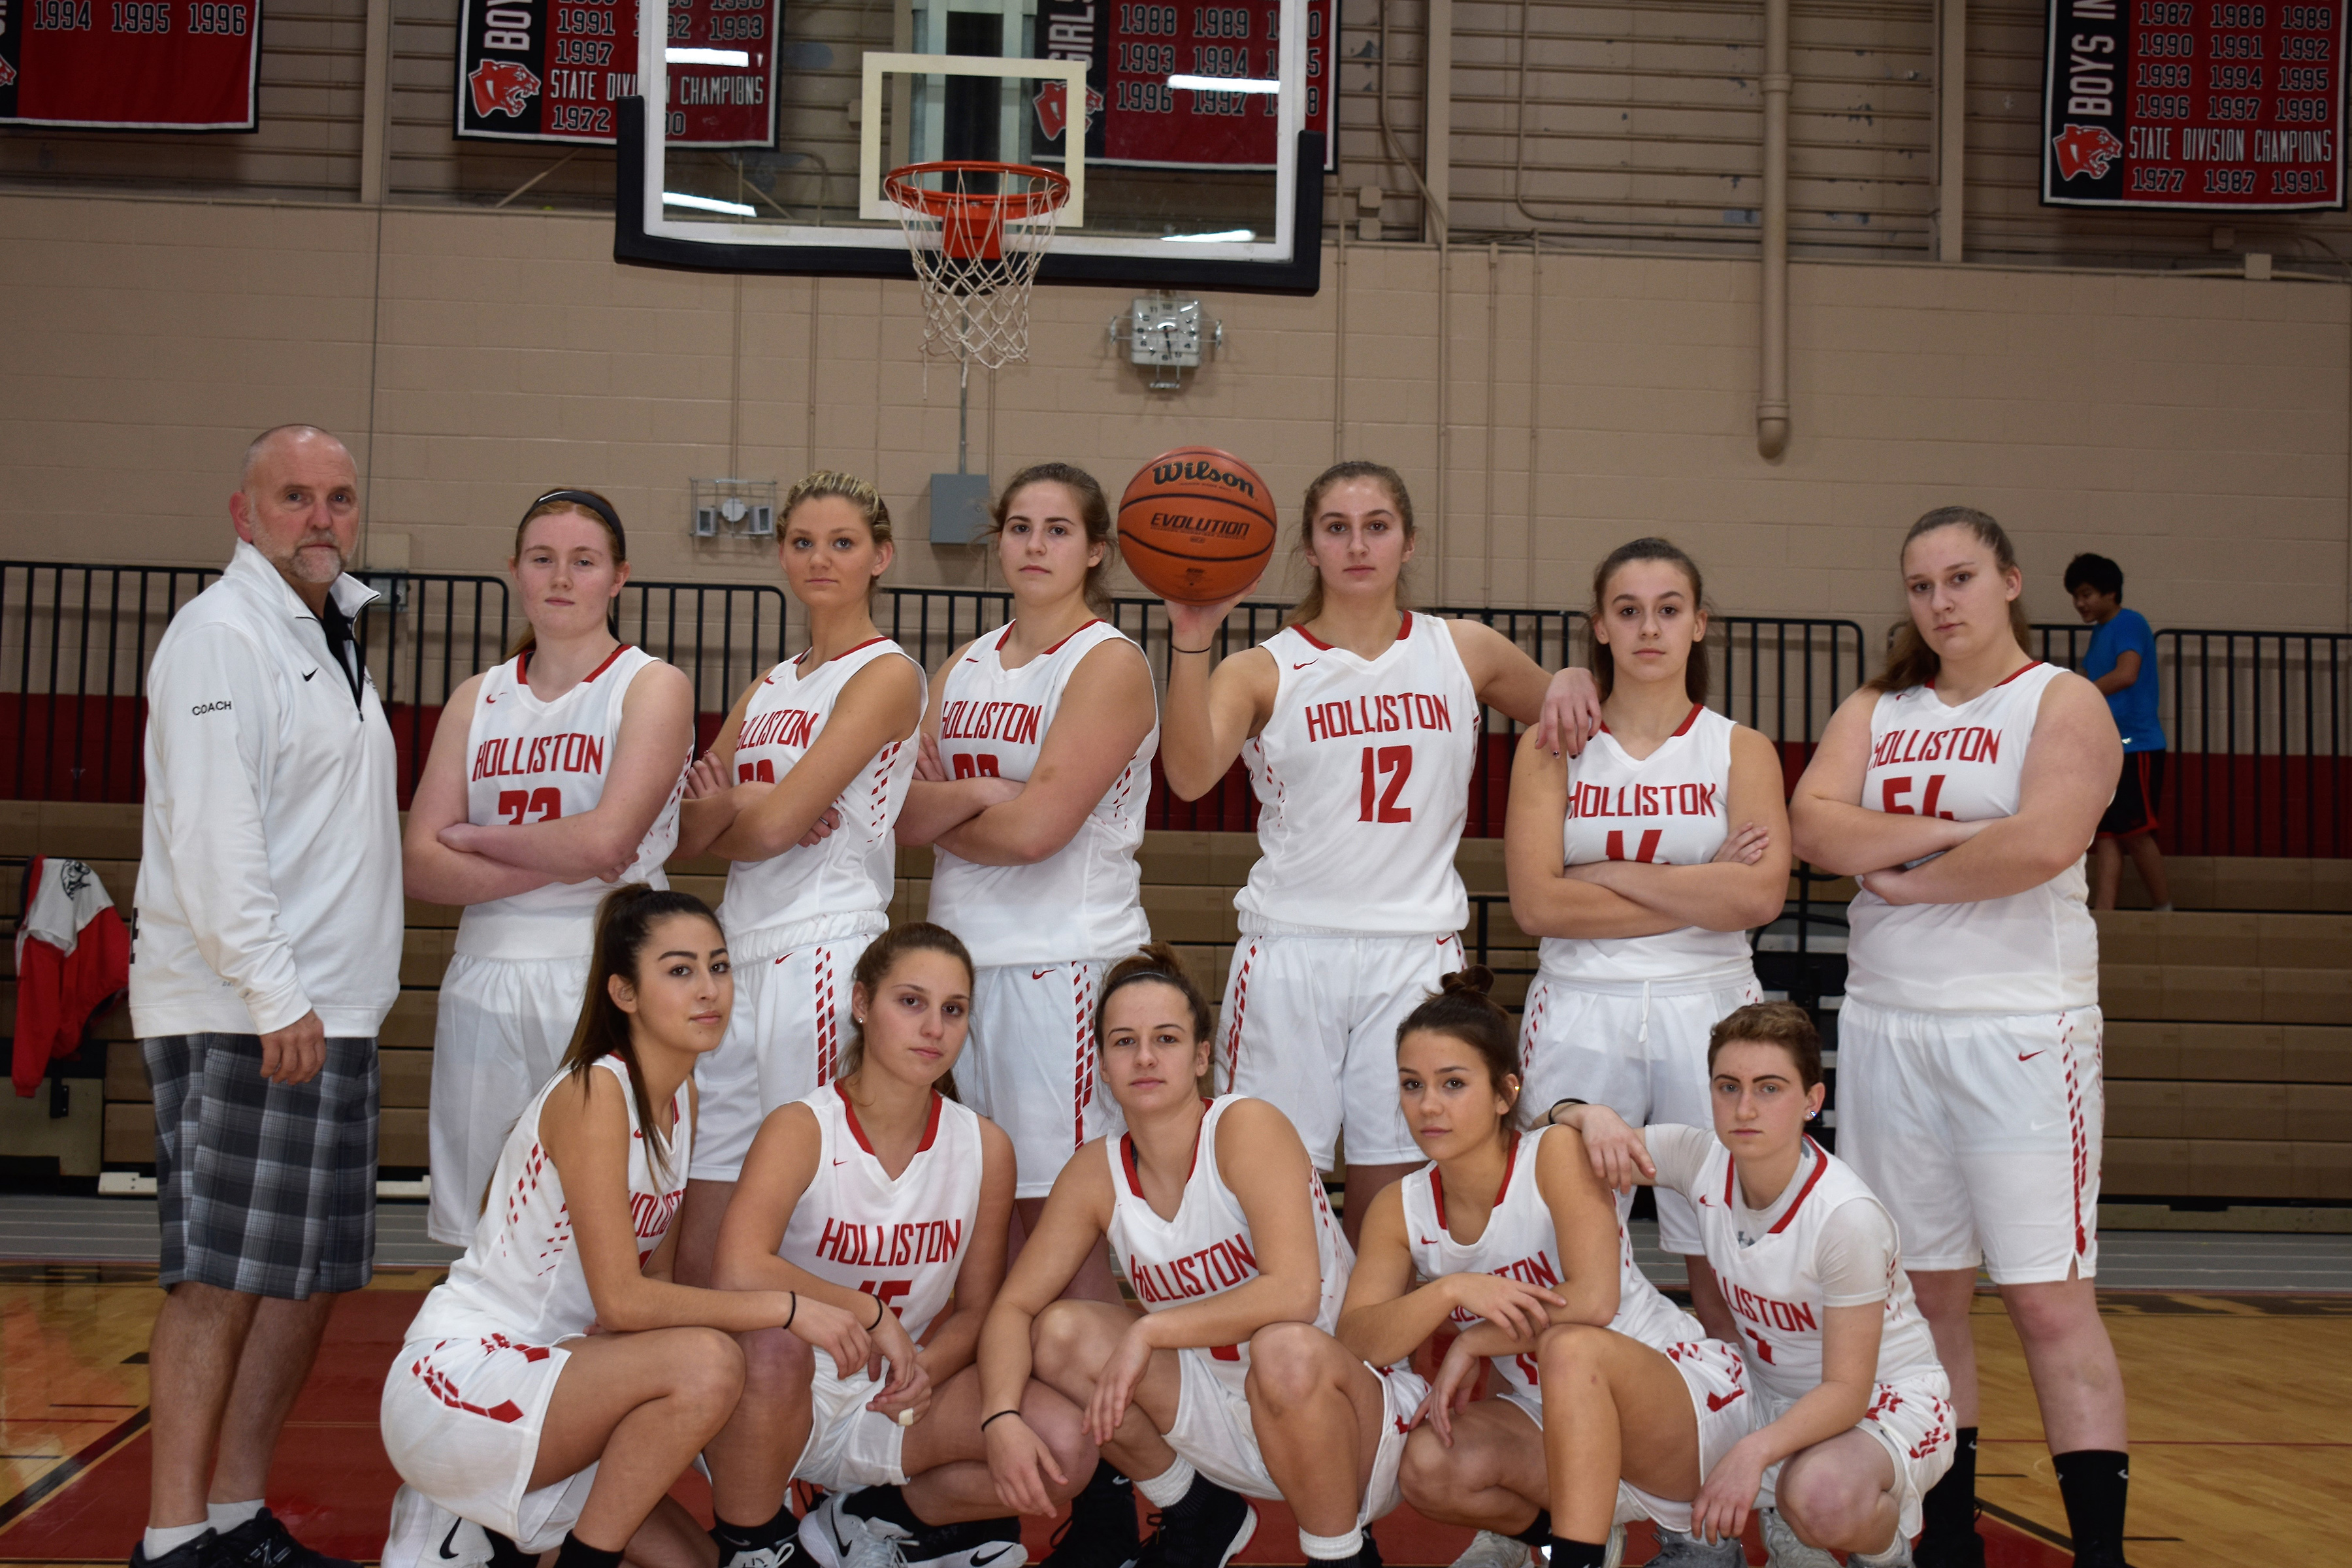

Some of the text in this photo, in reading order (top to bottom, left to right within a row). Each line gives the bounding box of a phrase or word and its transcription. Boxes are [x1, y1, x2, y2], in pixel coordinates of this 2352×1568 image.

[33, 0, 91, 30] 1994
[112, 3, 170, 33] 1995
[188, 3, 246, 35] 1996
[557, 9, 615, 36] 1991
[710, 15, 764, 41] 1993
[1119, 5, 1176, 35] 1988
[1194, 8, 1249, 39] 1989
[2139, 2, 2331, 30] 1987 1988 1989
[555, 40, 613, 65] 1997
[1119, 43, 1175, 73] 1993
[1193, 46, 1248, 78] 1994
[2138, 33, 2330, 61] 1990 1991 1992
[550, 69, 596, 100] STATE
[680, 76, 764, 105] CHAMPIONS
[2068, 34, 2115, 116] BOYS
[2137, 64, 2328, 91] 1993 1994 1995
[1117, 81, 1173, 112] 1996
[2136, 95, 2327, 122] 1996 1997 1998
[552, 105, 611, 132] 1972
[2129, 126, 2332, 163] STATE DIVISION CHAMPIONS
[2132, 167, 2327, 193] 1977 1987 1991
[1152, 461, 1254, 498] Wilson
[1151, 513, 1250, 536] EVOLUTION
[192, 700, 232, 716] COACH
[941, 701, 1042, 745] HOLLISTON
[1305, 692, 1452, 742] HOLLISTON
[472, 732, 604, 781] HOLLISTON
[1867, 727, 2002, 771] HOLLISTON
[1358, 745, 1413, 823] 12
[1568, 781, 1716, 819] HOLLISTON
[816, 1217, 961, 1266] HOLLISTON
[1131, 1233, 1258, 1303] HOLLISTON
